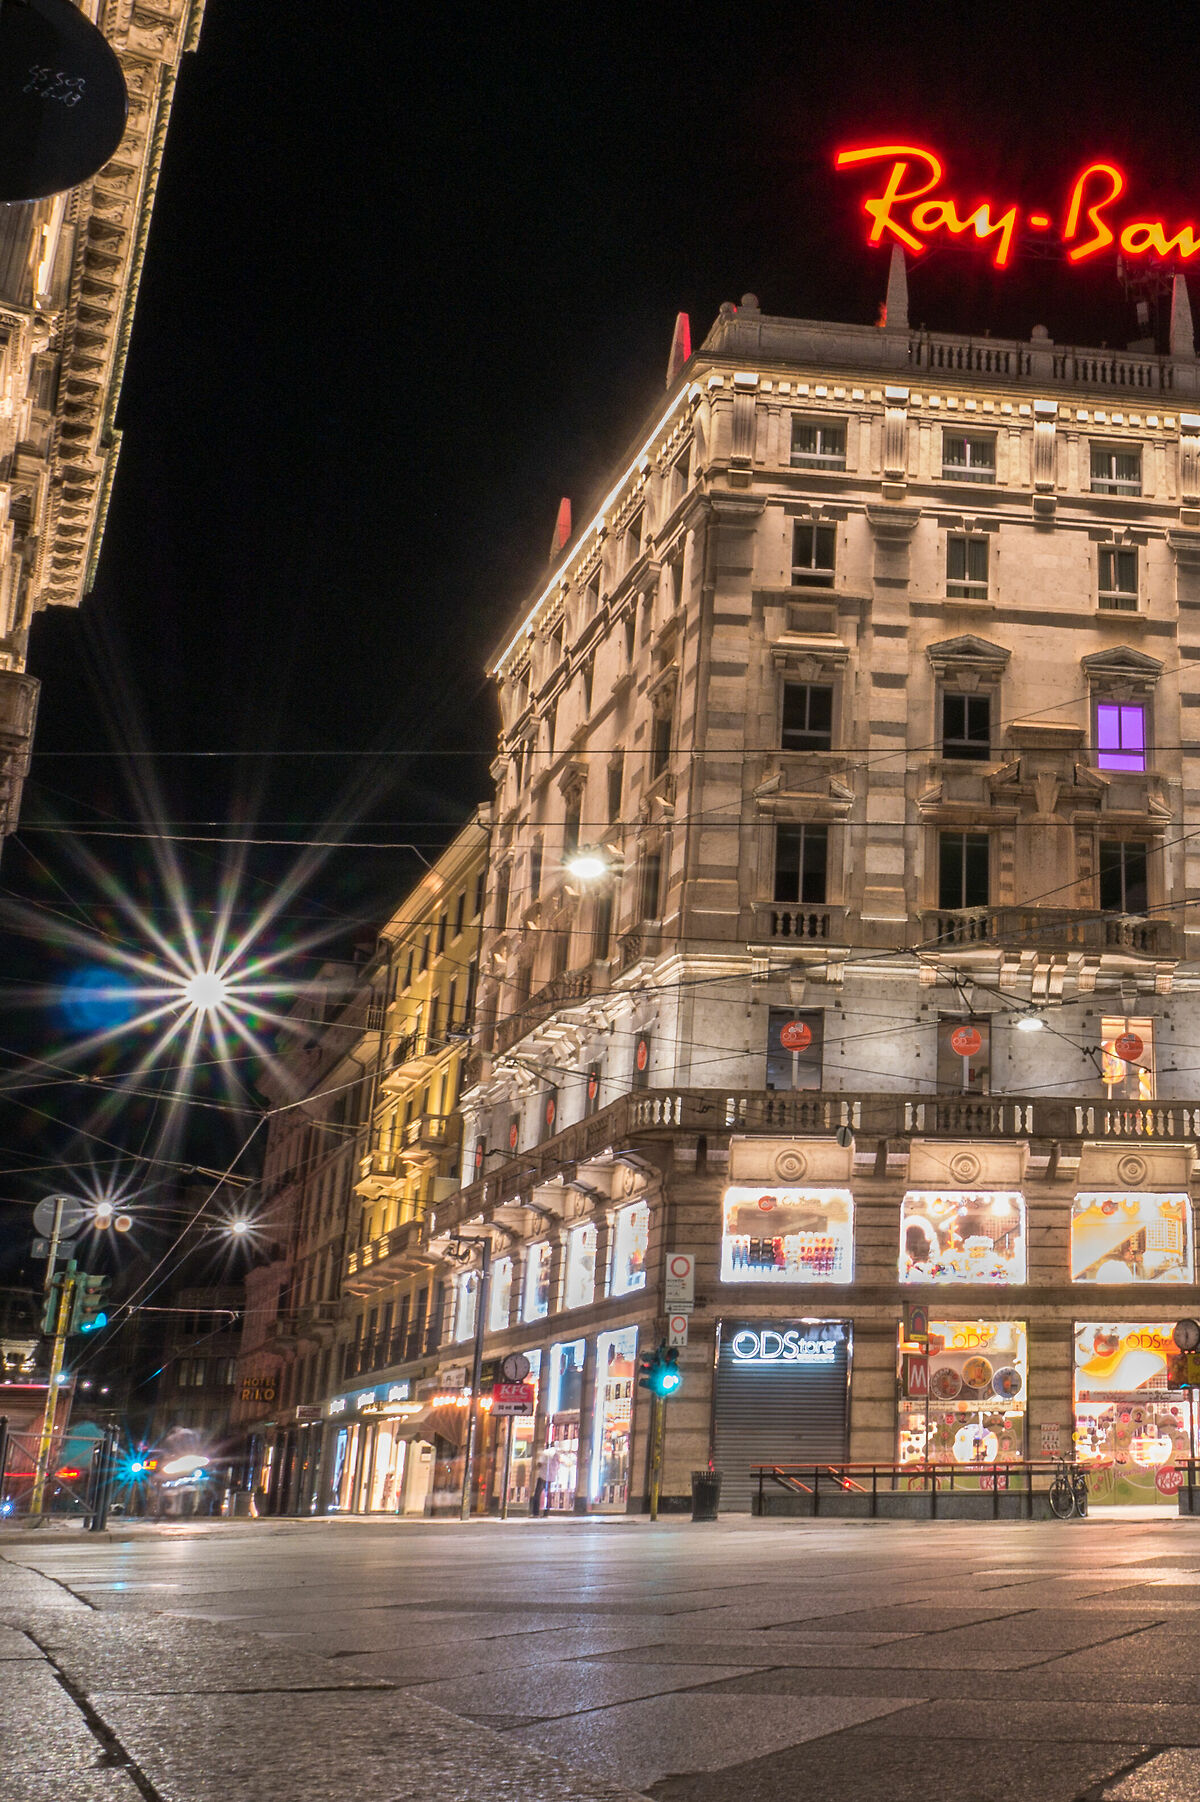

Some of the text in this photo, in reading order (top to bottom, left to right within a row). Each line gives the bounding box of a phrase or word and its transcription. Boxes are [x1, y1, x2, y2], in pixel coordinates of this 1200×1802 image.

[243, 1375, 276, 1386] HOTEL
[910, 1364, 928, 1389] M
[241, 1388, 275, 1401] RIO
[500, 1384, 529, 1396] KFC
